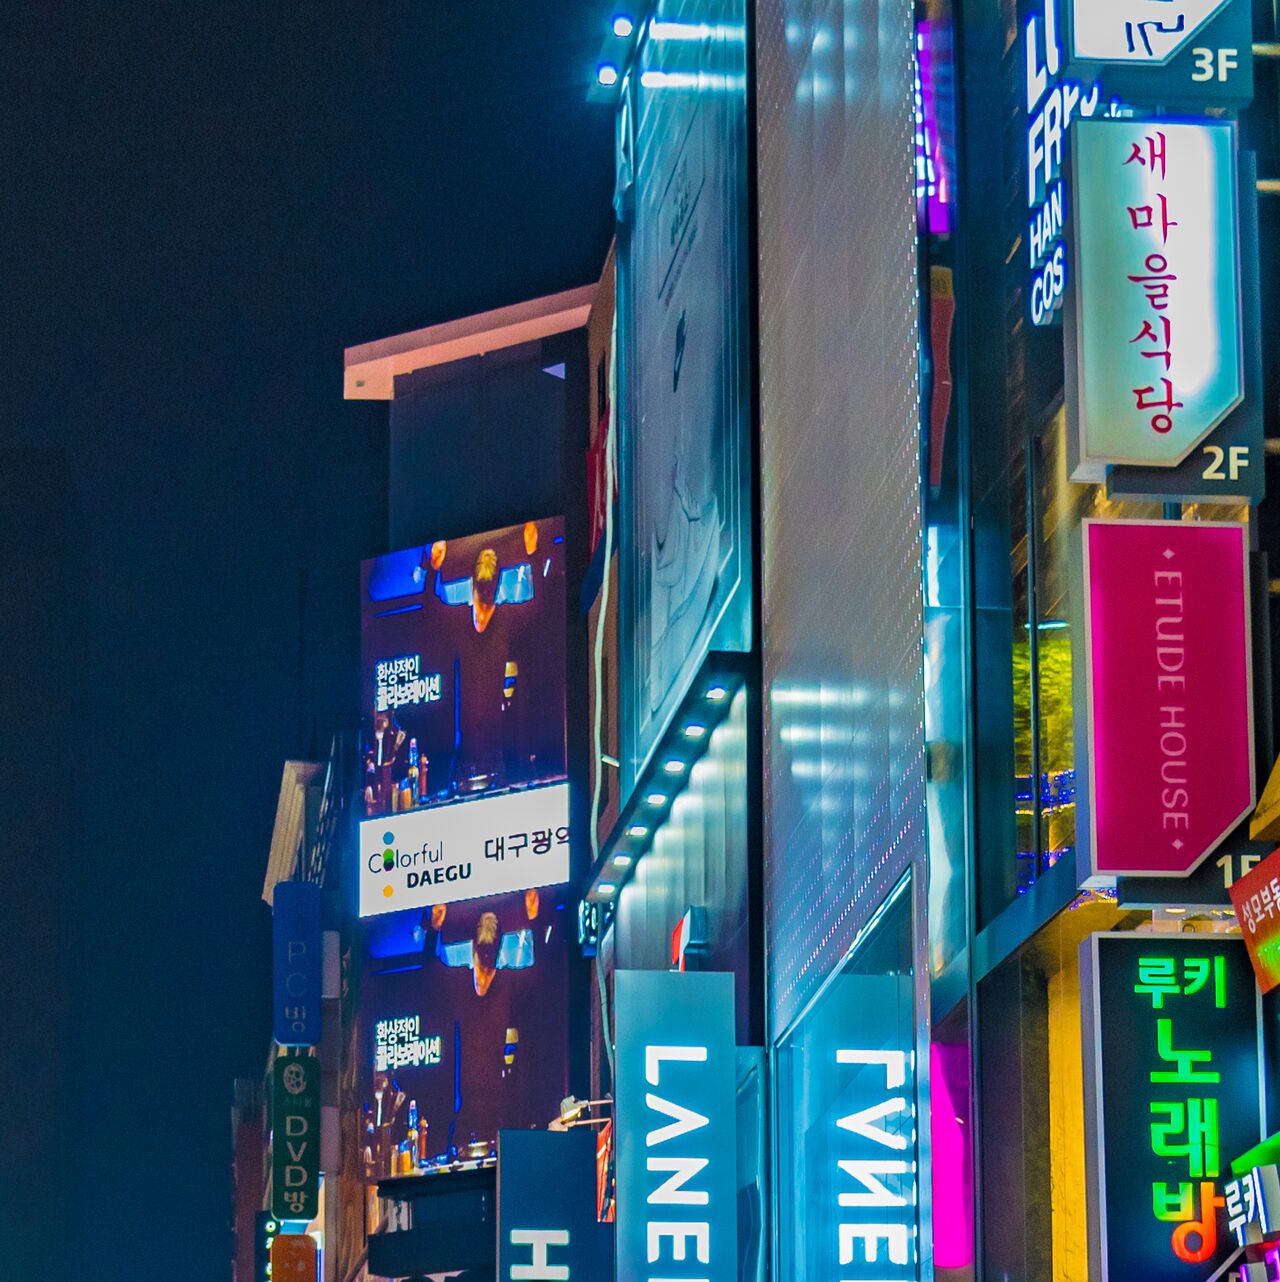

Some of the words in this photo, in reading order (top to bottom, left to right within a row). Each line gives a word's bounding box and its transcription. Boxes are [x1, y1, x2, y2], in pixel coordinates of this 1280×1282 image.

[1191, 47, 1239, 83] 3F
[1122, 130, 1184, 435] 새마을식당
[1202, 446, 1250, 481] 2F
[1152, 570, 1186, 692] ETUDE
[376, 655, 420, 687] 환상적인
[376, 674, 441, 712] 콜라보레이션
[1159, 705, 1190, 833] HOUSE
[407, 863, 472, 889] DAEGU
[1133, 954, 1227, 1010] 루키
[376, 1015, 420, 1045] 환상적인
[376, 1036, 441, 1072] 콜라보레이션
[284, 1115, 308, 1214] DVD방
[1147, 1019, 1227, 1265] 노래방
[1223, 1165, 1268, 1248] 루키
